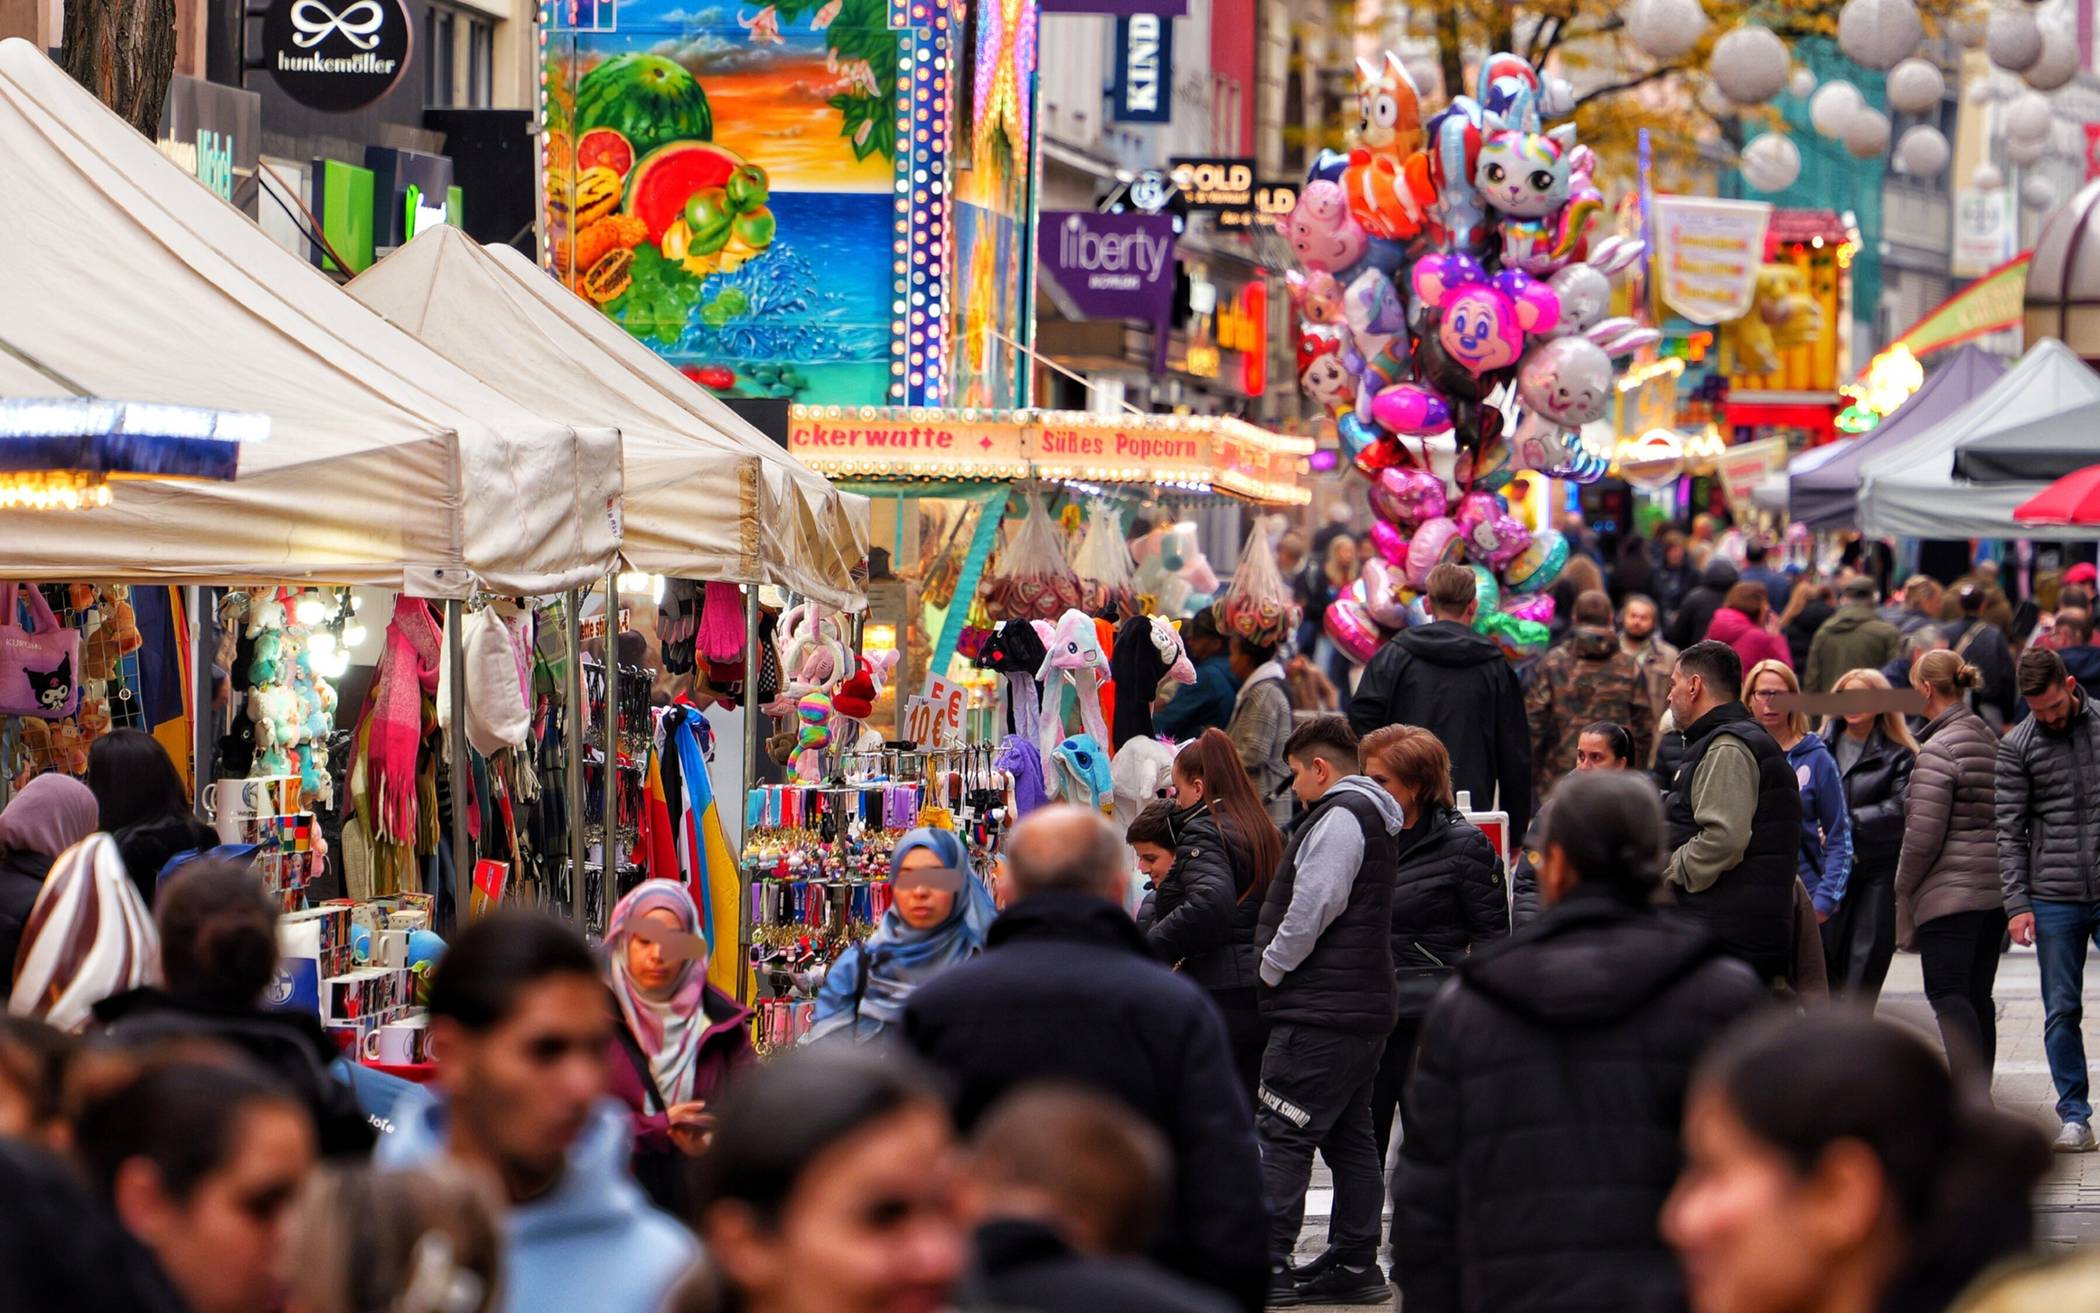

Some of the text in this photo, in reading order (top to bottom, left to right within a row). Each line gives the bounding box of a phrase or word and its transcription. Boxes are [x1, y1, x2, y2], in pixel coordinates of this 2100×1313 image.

[277, 50, 395, 75] hunkemöller
[1127, 13, 1160, 112] KIND
[1060, 215, 1168, 282] liberty
[793, 424, 953, 449] ckerwatte
[1116, 433, 1196, 459] Popcorn
